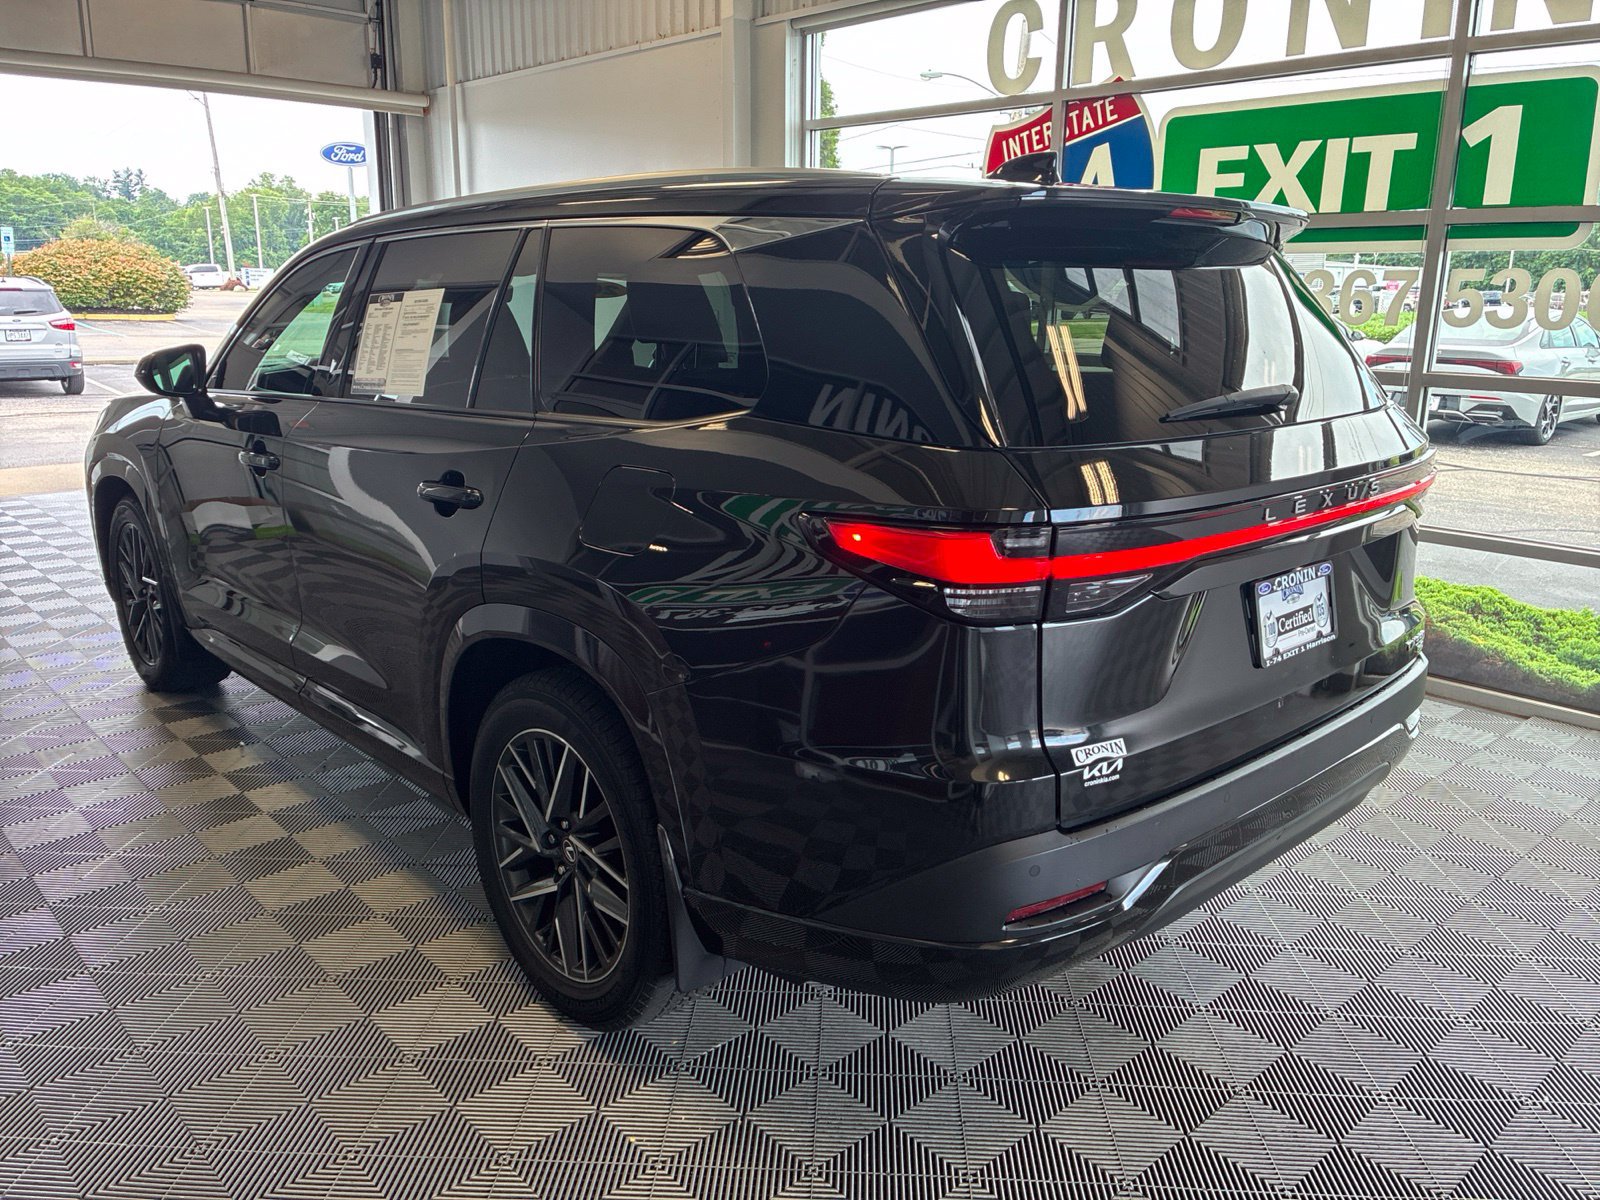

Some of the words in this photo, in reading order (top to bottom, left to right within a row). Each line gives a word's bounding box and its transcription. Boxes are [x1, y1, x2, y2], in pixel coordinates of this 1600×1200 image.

[987, 0, 1593, 95] CRO
[1002, 97, 1118, 162] INTERTATE
[331, 145, 364, 161] Ford
[1199, 132, 1418, 213] EXIT
[1462, 105, 1523, 205] 1
[1265, 480, 1381, 521] LEXUS
[1274, 566, 1316, 591] CRONIN
[1278, 607, 1313, 632] Certified
[1283, 648, 1299, 659] EXIT
[1306, 634, 1336, 650] Harrison
[1075, 740, 1124, 763] CRONIN
